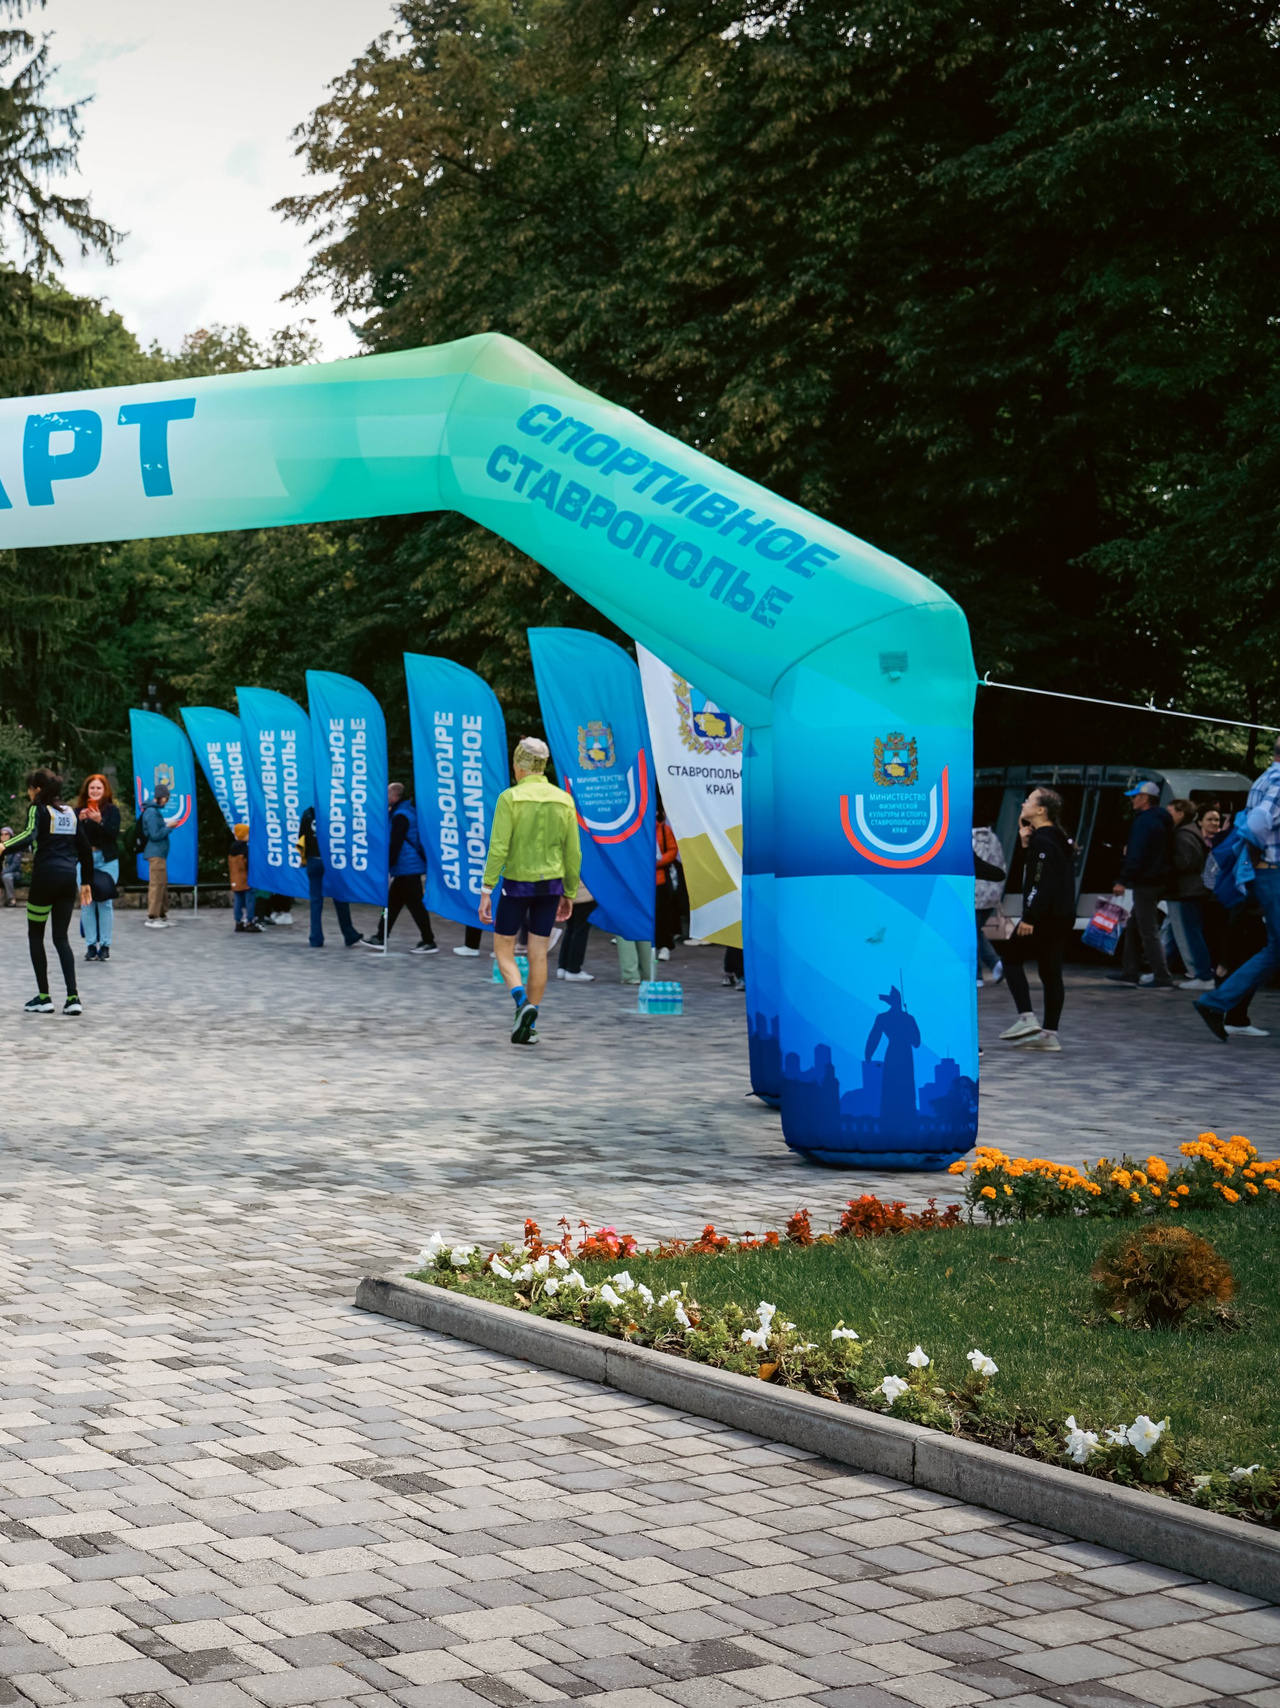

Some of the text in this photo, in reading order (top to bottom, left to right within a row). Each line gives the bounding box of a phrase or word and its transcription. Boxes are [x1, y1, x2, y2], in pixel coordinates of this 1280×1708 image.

[485, 444, 794, 630] СТАВРОПОЛЬЕ
[516, 404, 840, 579] СПОРТИВНОЕ
[259, 730, 283, 867] СПОРТИВНОЕ
[280, 730, 303, 869] СТАВРОПОЛЬЕ
[329, 718, 347, 870] СПОРТИВНОЕ
[350, 718, 368, 871] СТАВРОПОЛЬЕ
[667, 765, 742, 779] СТАВРОПОЛЬ
[705, 783, 734, 795] КРАЙ
[869, 793, 926, 801] МИНИСТЕРСТВО
[879, 801, 918, 809] ФИЗИЧЕСКОЙ
